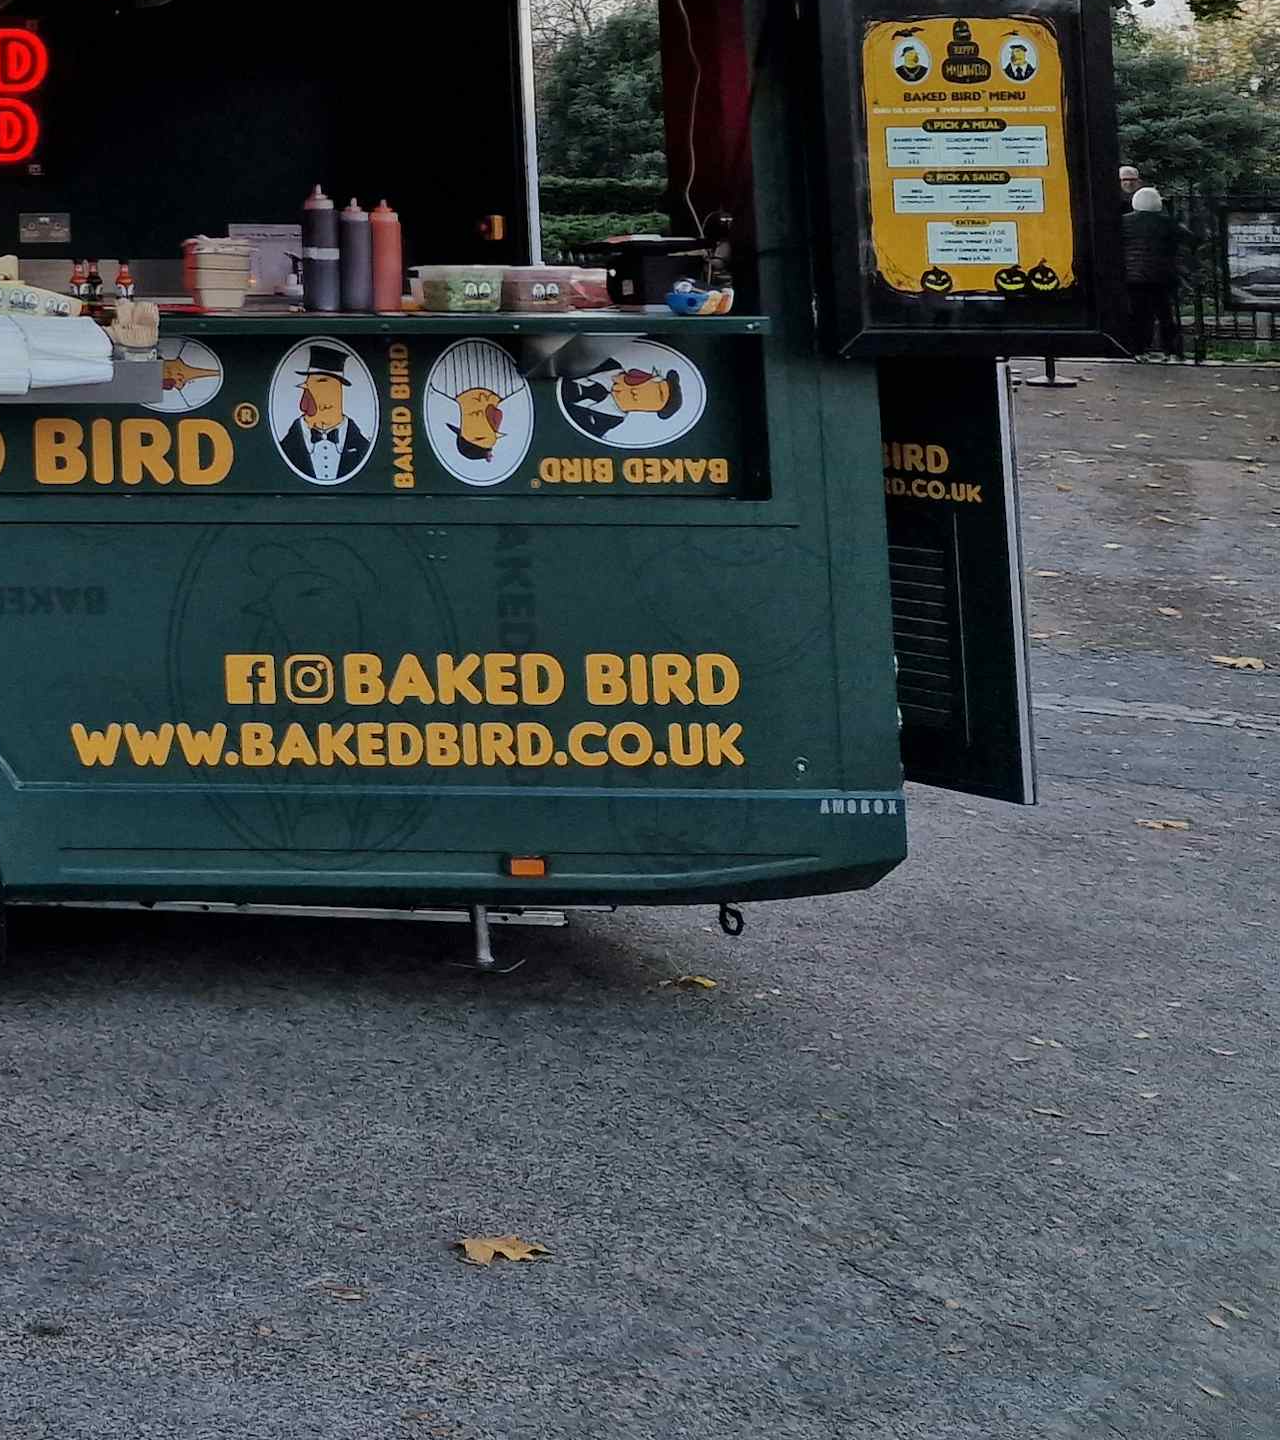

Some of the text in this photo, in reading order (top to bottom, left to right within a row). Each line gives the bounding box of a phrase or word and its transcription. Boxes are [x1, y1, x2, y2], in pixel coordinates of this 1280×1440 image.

[903, 91, 947, 102] BAKED
[988, 90, 1027, 101] MENU
[933, 121, 959, 130] PICK
[960, 122, 969, 130] A
[936, 173, 961, 182] PICK
[962, 173, 971, 182] A
[388, 341, 417, 490] BAKED BIRD
[539, 456, 730, 486] BAKED BIRD
[344, 653, 741, 706] BAKED BIRD
[70, 723, 746, 768] WWW.BAKEDBIRD.CO.UK
